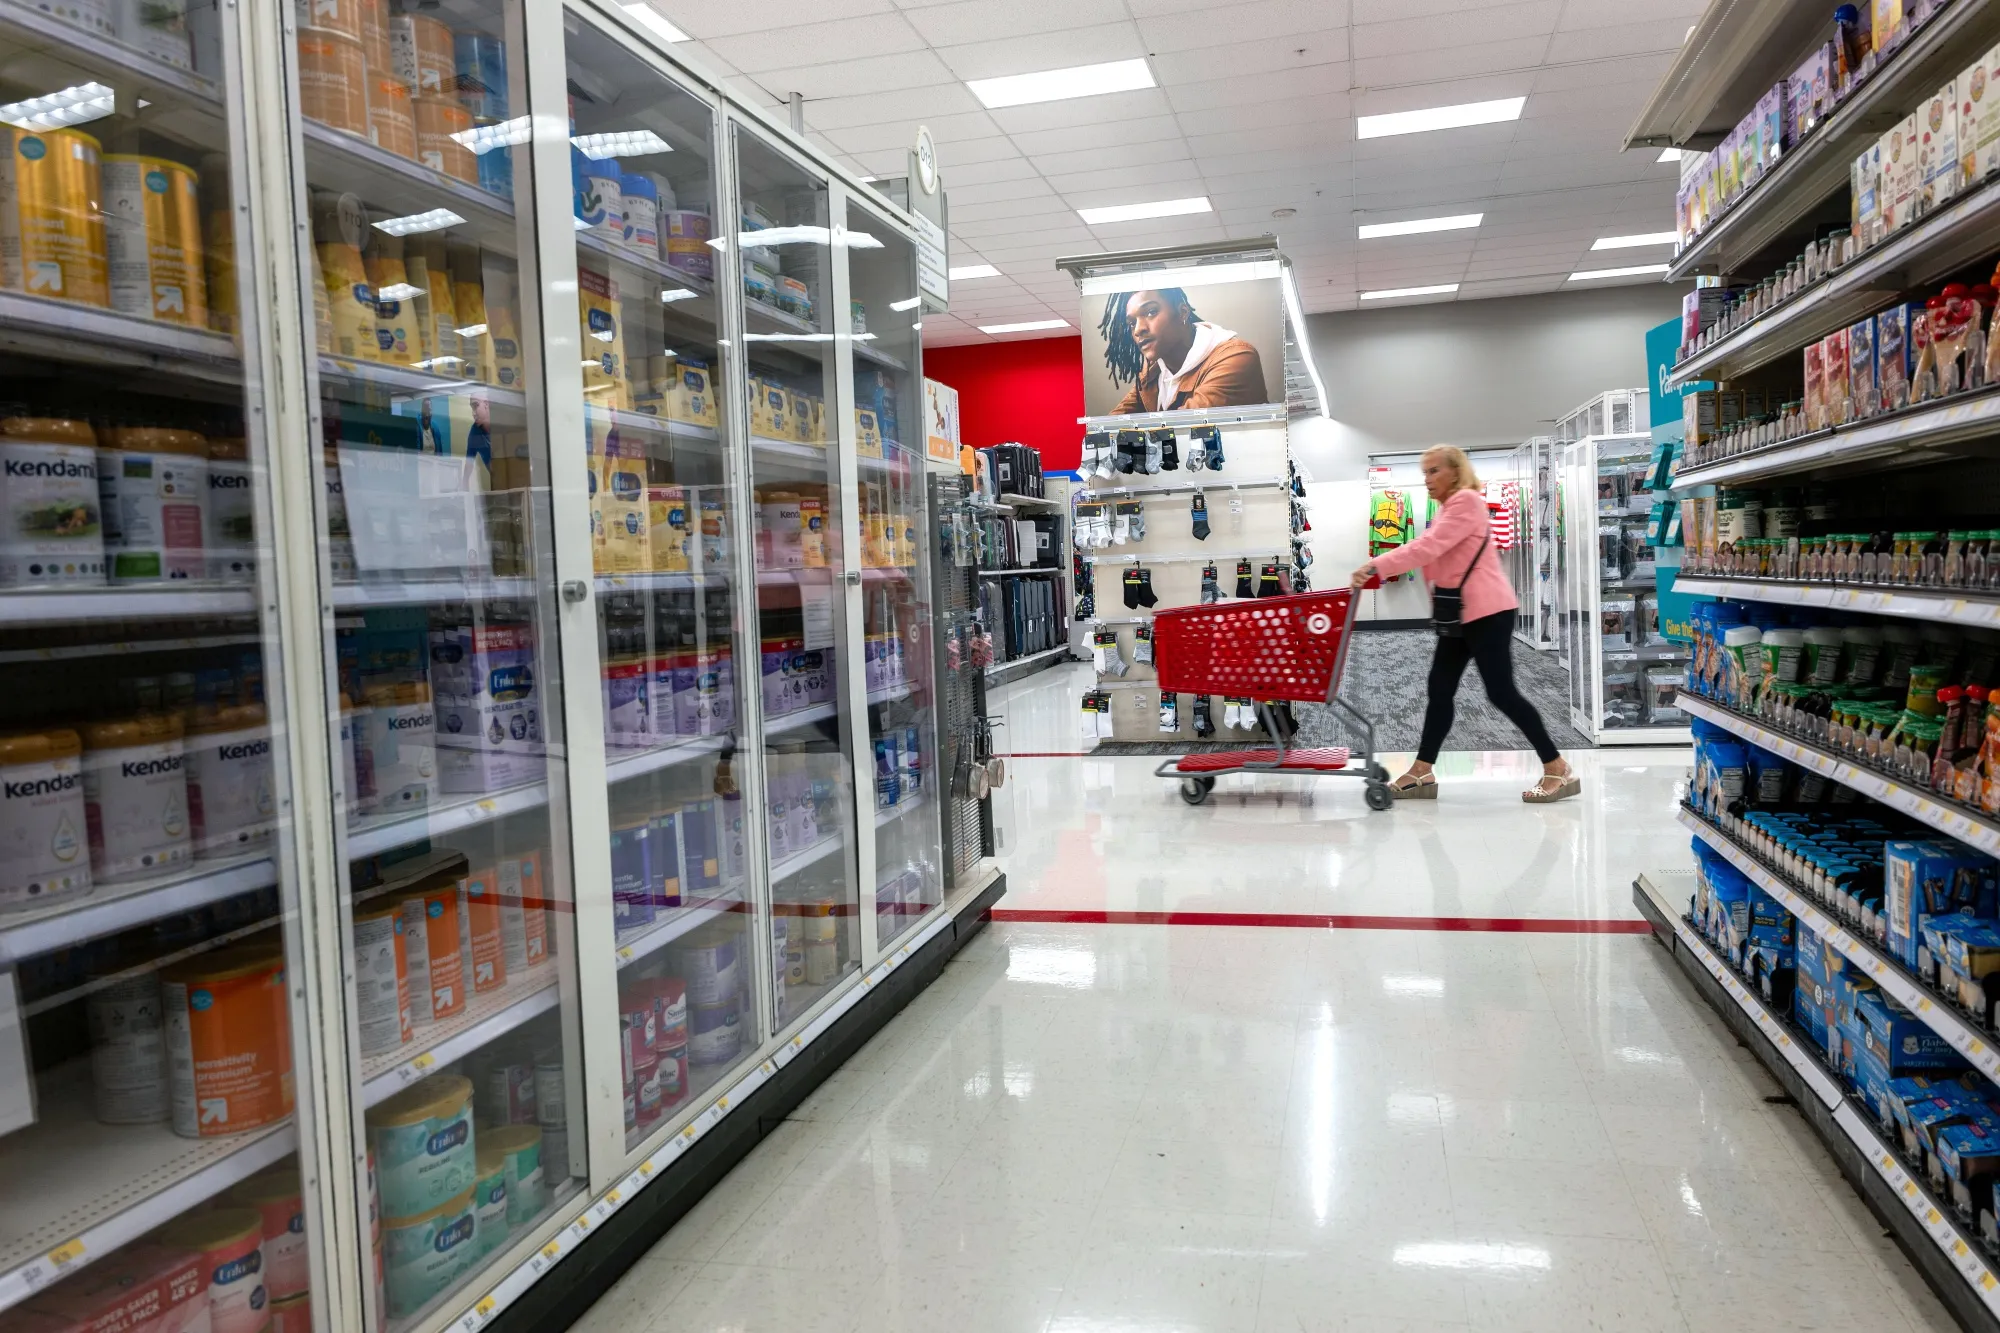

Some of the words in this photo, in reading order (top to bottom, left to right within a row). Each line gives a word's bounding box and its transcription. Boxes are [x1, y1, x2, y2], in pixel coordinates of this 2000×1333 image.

[1666, 619, 1681, 636] Give
[219, 740, 269, 761] Kenda
[122, 755, 184, 778] Kenda
[4, 773, 82, 799] Kenda
[614, 873, 633, 882] entle
[614, 878, 643, 890] remium
[196, 1065, 252, 1081] premium
